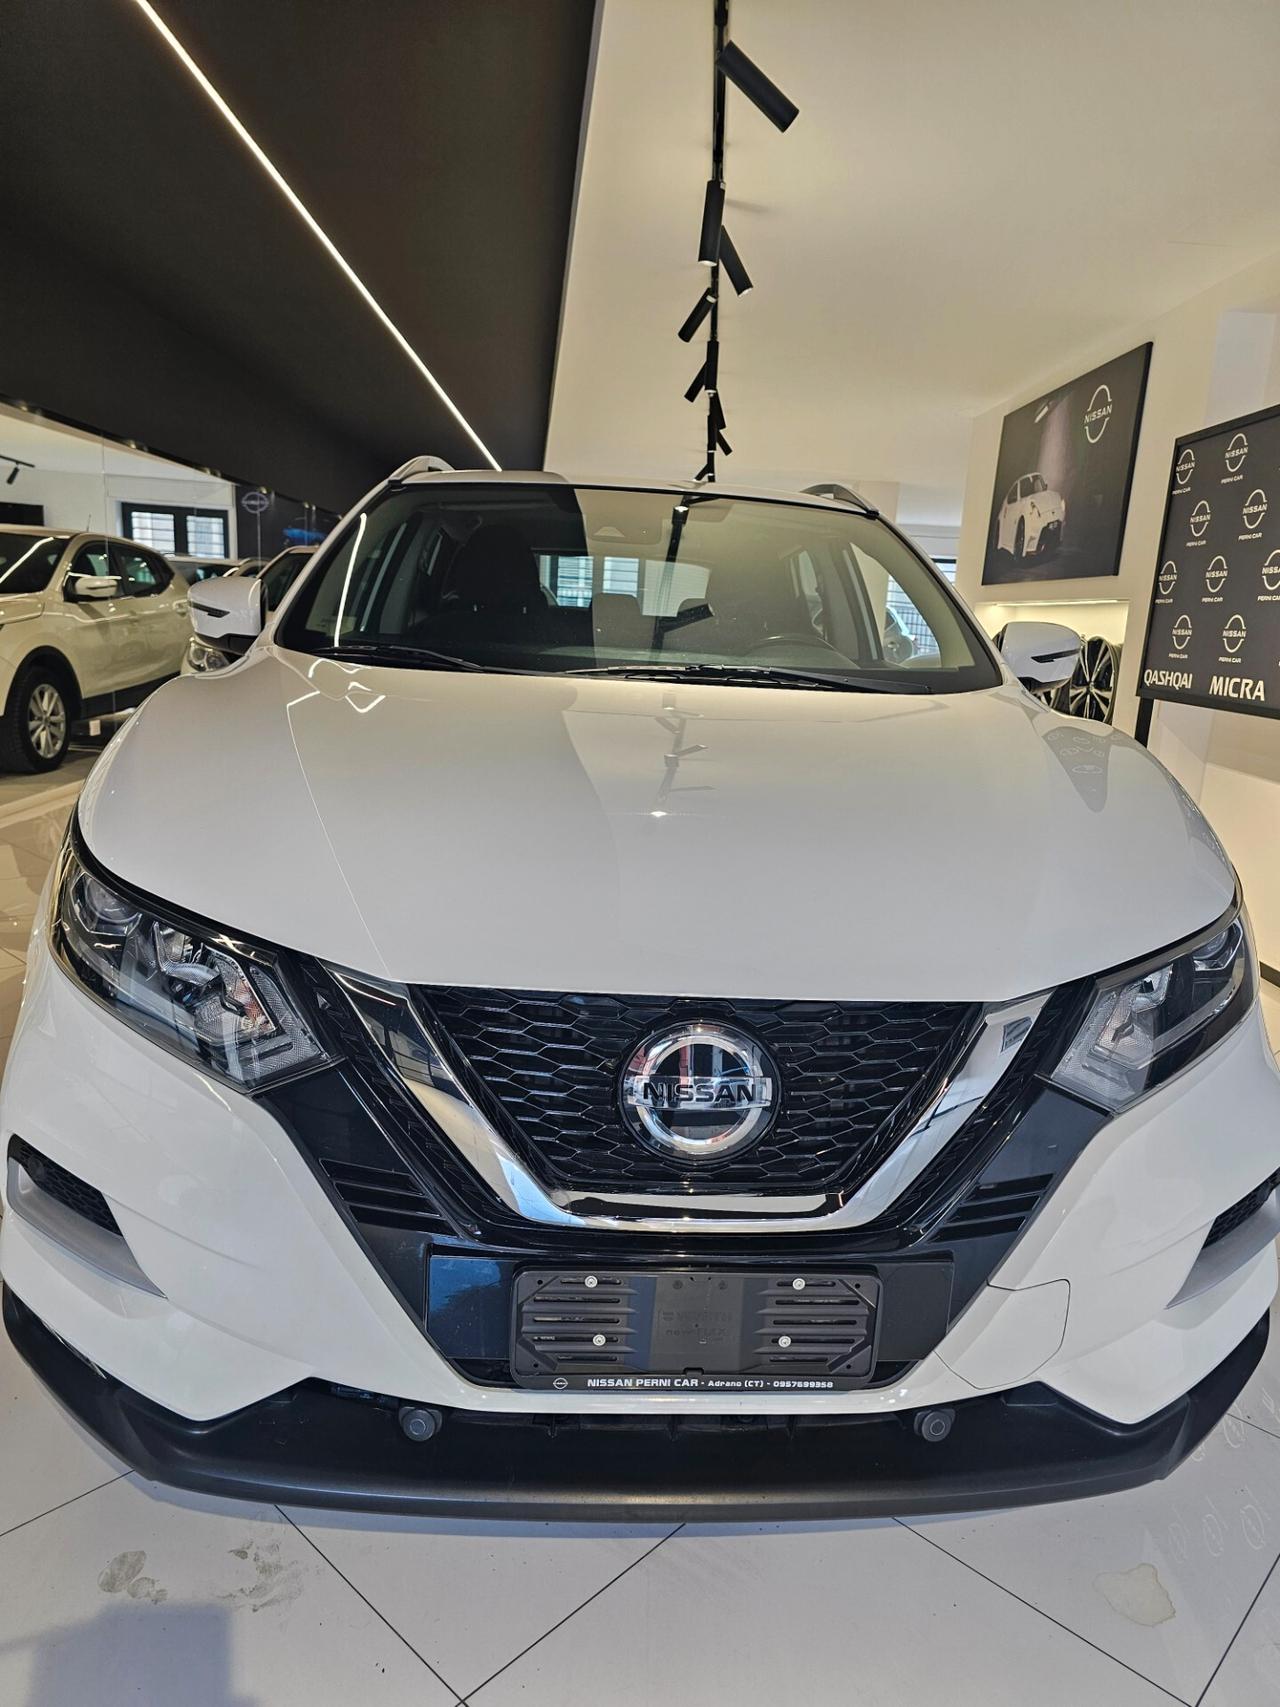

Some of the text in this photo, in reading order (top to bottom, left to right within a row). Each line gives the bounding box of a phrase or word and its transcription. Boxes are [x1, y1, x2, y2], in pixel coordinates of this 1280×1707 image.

[1084, 404, 1112, 423] NISSAN
[1225, 446, 1248, 459] NISSAN
[1176, 461, 1196, 472] NISSAN
[1242, 503, 1268, 514] NISSAN
[1190, 513, 1211, 523] NISSAN
[1206, 570, 1228, 578] NISSAN
[1262, 566, 1280, 574] NISS
[1172, 628, 1192, 636] NISSAN
[1222, 630, 1246, 638] NISSAN
[1144, 669, 1193, 690] QASHQAI
[1209, 676, 1265, 701] MICRA
[643, 1082, 756, 1103] NISSAN
[587, 1378, 633, 1387] NISSAN
[635, 1378, 671, 1387] PERNI
[674, 1378, 699, 1387] CAR
[744, 1380, 764, 1388] (CT)
